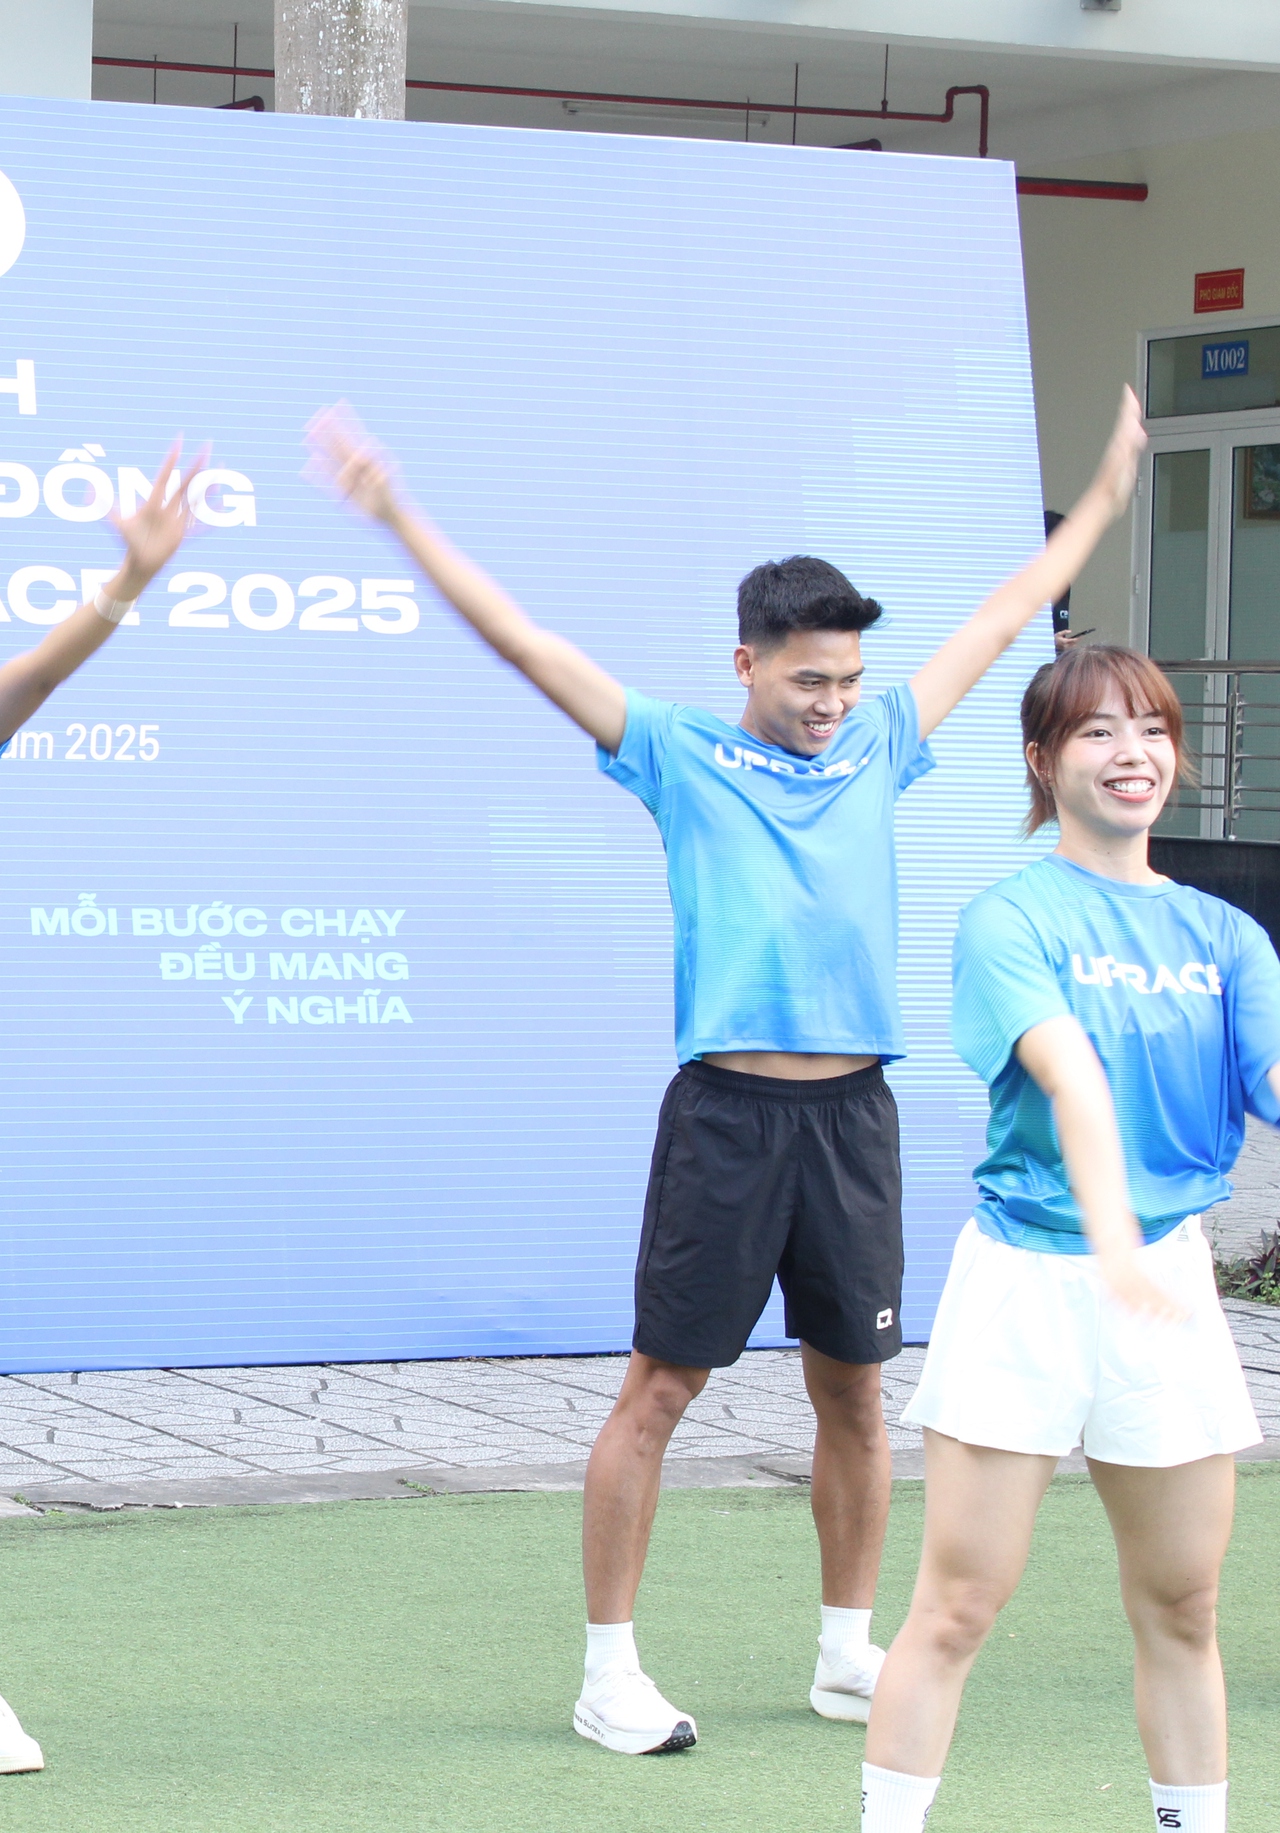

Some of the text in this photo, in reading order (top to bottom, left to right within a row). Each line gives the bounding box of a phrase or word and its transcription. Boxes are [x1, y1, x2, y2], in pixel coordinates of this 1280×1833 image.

[1205, 347, 1245, 372] M002
[167, 571, 420, 634] 2025
[64, 723, 160, 761] 2025
[30, 893, 406, 944] MỖI BƯỚC CHẠY
[159, 942, 410, 981] ĐỀU MANG
[221, 989, 414, 1025] Ý NGHĨA
